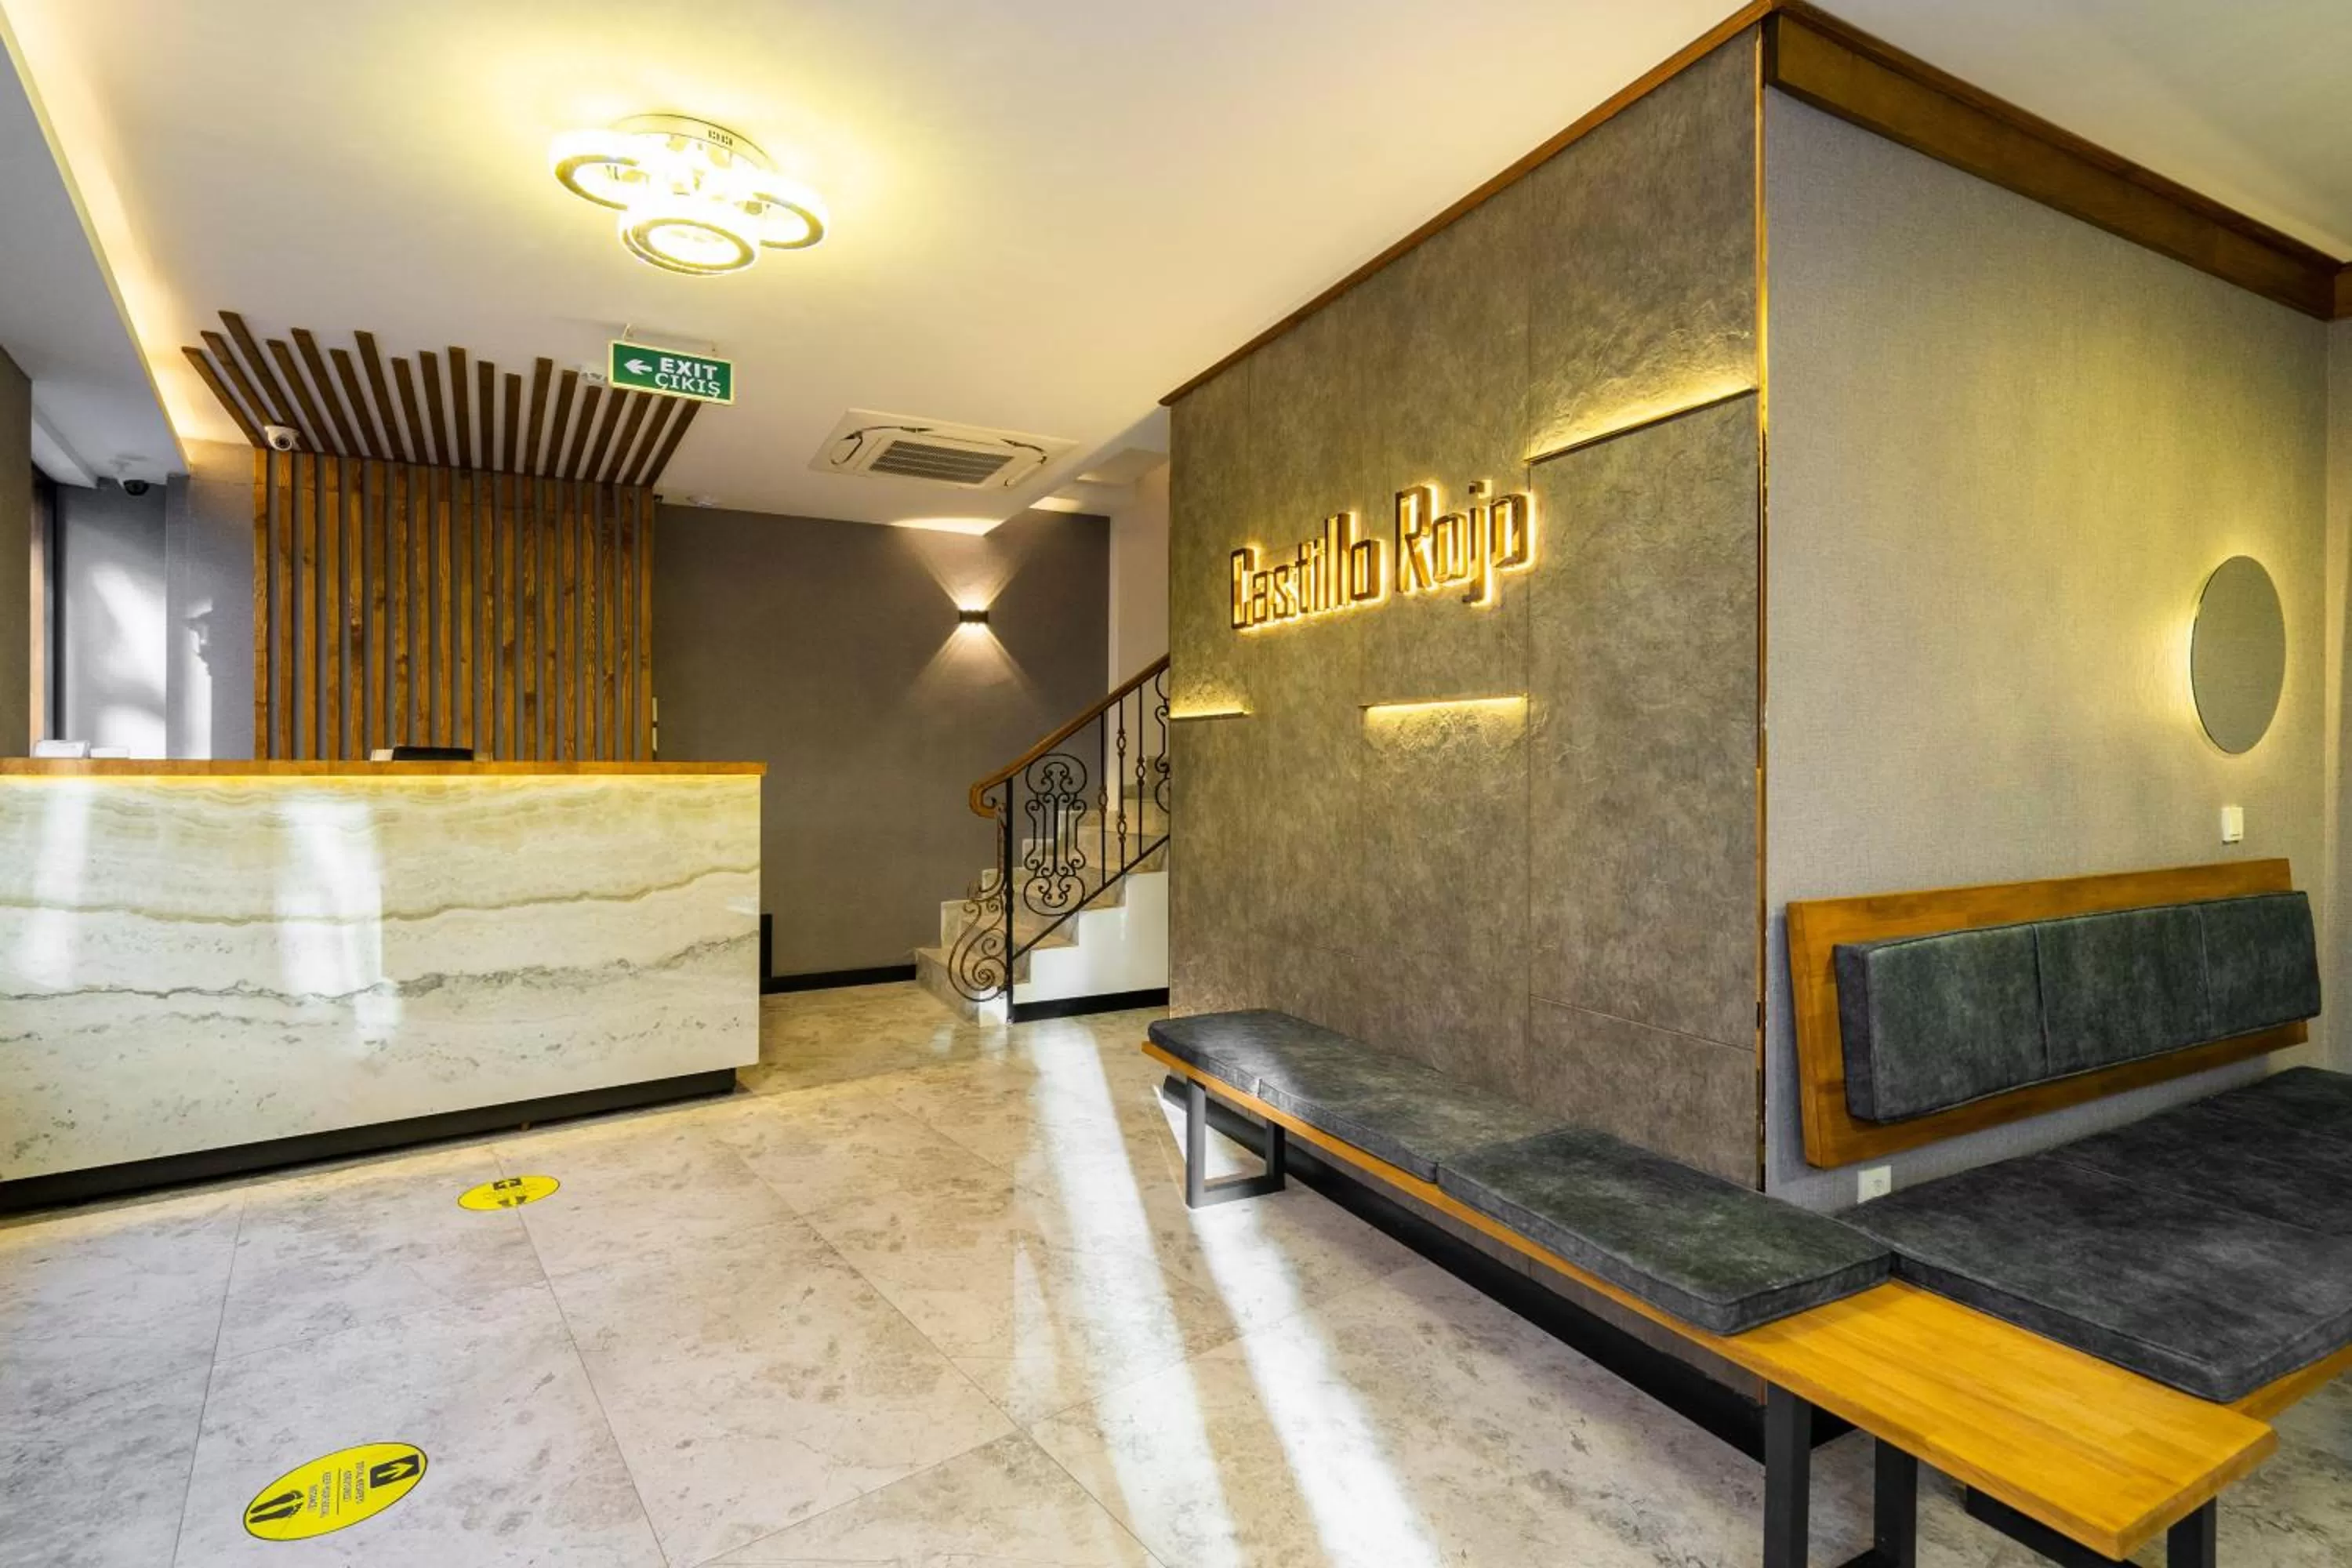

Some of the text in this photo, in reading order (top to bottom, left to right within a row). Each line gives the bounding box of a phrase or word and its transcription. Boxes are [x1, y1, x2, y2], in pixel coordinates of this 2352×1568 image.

[659, 357, 718, 380] EXIT
[655, 372, 721, 398] ÇIKIŞ
[1230, 480, 1531, 629] Castillo Rojo
